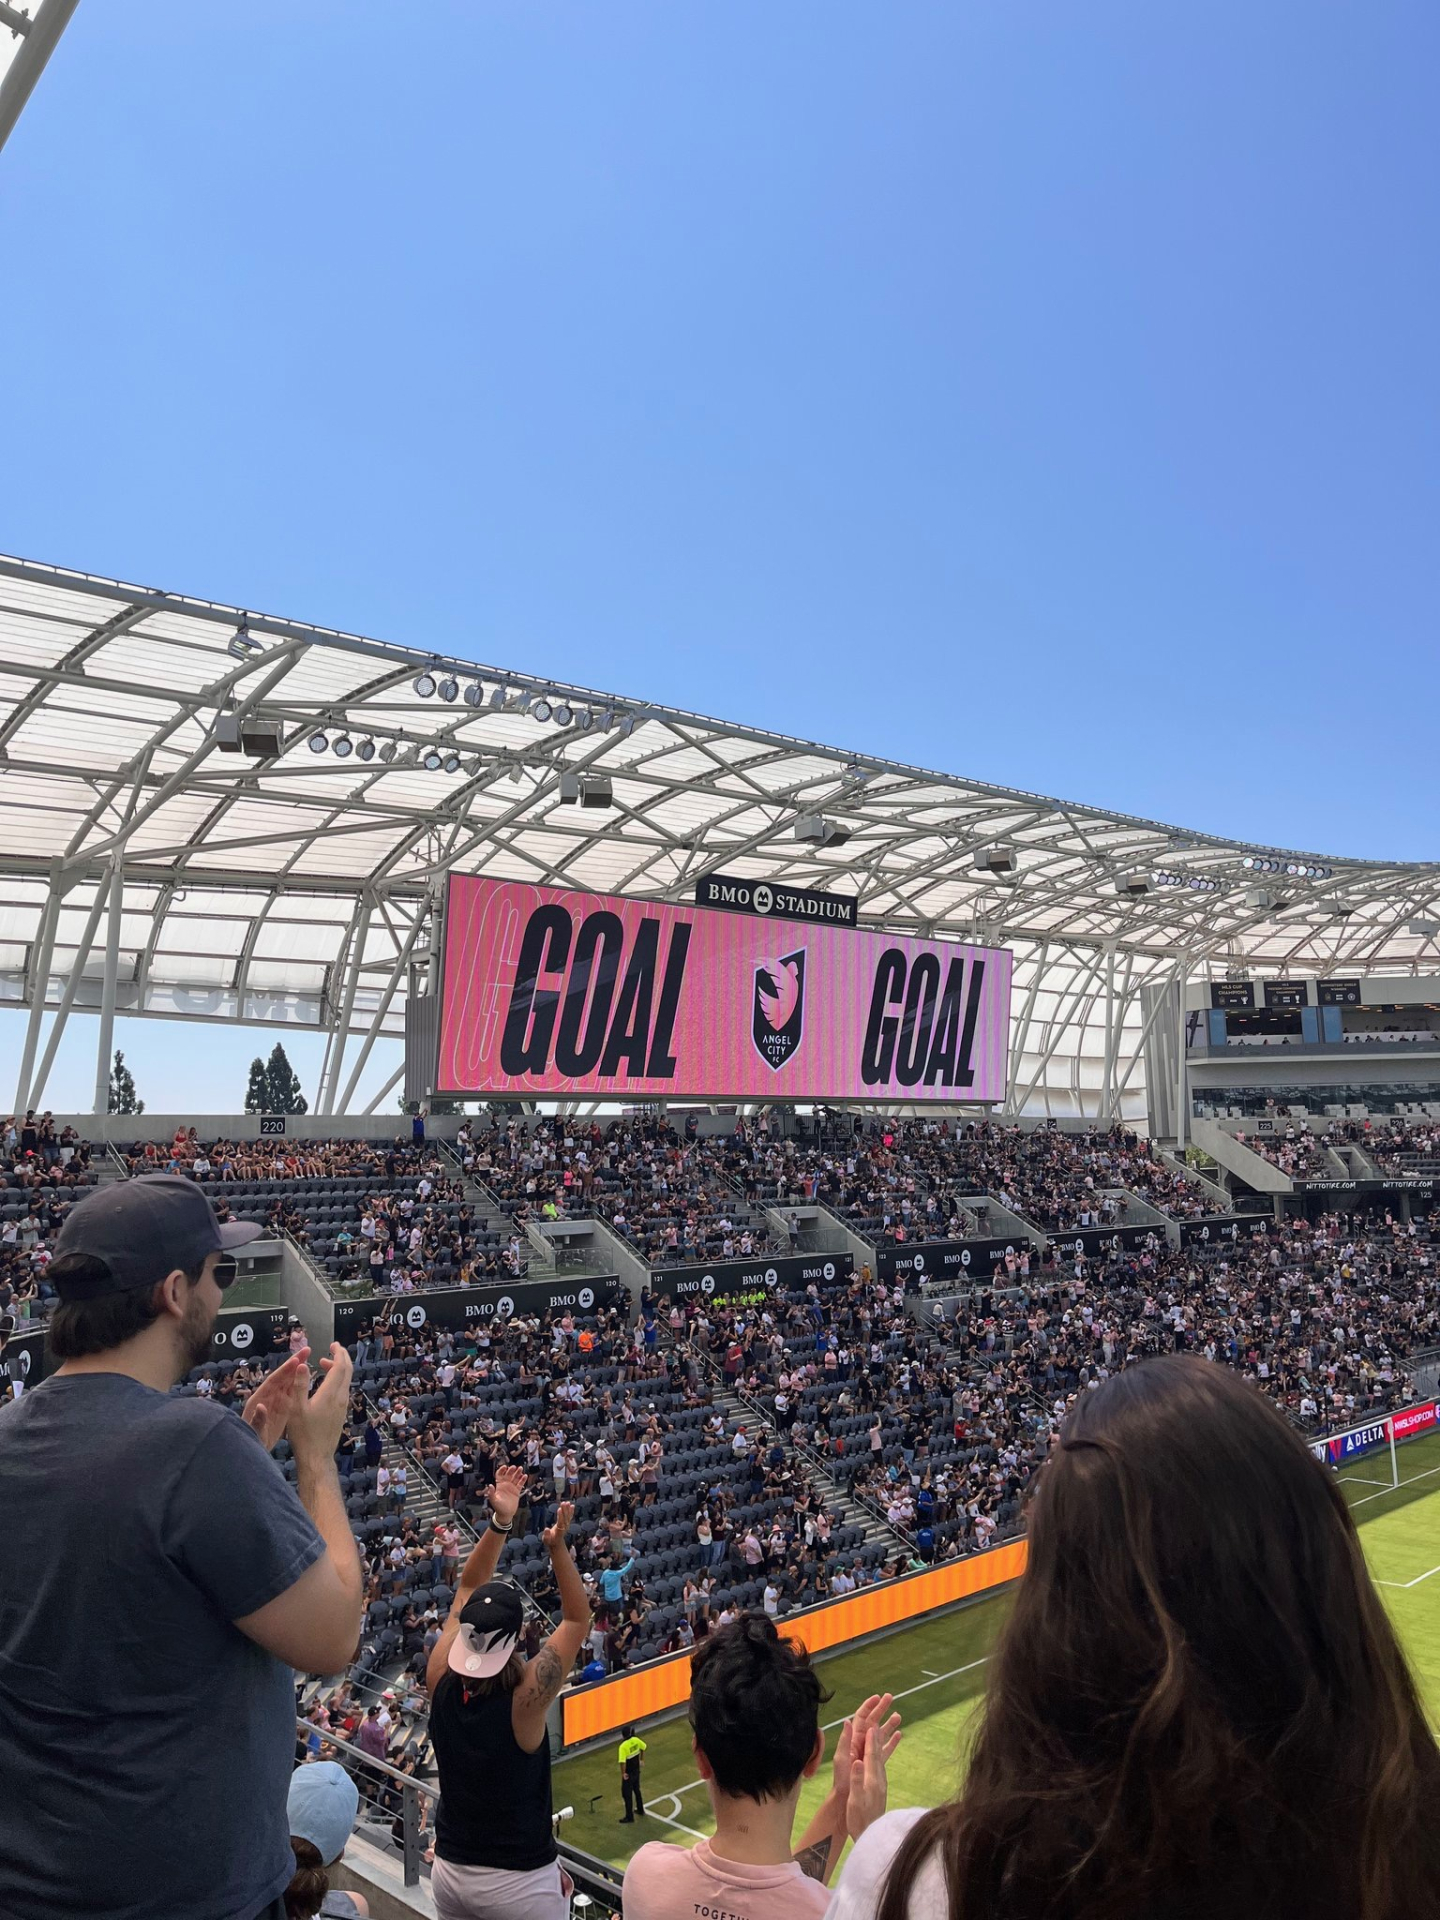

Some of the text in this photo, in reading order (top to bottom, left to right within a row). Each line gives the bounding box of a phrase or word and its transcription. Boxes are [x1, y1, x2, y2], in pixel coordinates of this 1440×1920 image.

[708, 883, 851, 920] BMO STADIUM
[500, 904, 692, 1078] GOAL
[861, 948, 985, 1087] GOAL
[762, 1034, 792, 1045] ANGEL
[767, 1045, 786, 1055] CITY
[262, 1121, 284, 1132] 220
[1259, 1122, 1272, 1130] 225
[1306, 1181, 1356, 1190] NITTOTIRE.COM
[1382, 1180, 1433, 1188] NITTOTIRE.COM
[1061, 1243, 1075, 1252] BMO
[944, 1254, 960, 1264] BMO
[989, 1250, 1005, 1259] BMO
[895, 1259, 913, 1269] BMO
[802, 1268, 822, 1279] BMO
[742, 1274, 763, 1285] BMO
[677, 1282, 699, 1293] BMO
[549, 1293, 576, 1307] BMO
[338, 1307, 354, 1315] 120
[465, 1303, 494, 1317] BMO
[270, 1314, 284, 1322] 119
[1355, 1425, 1385, 1447] DELTA
